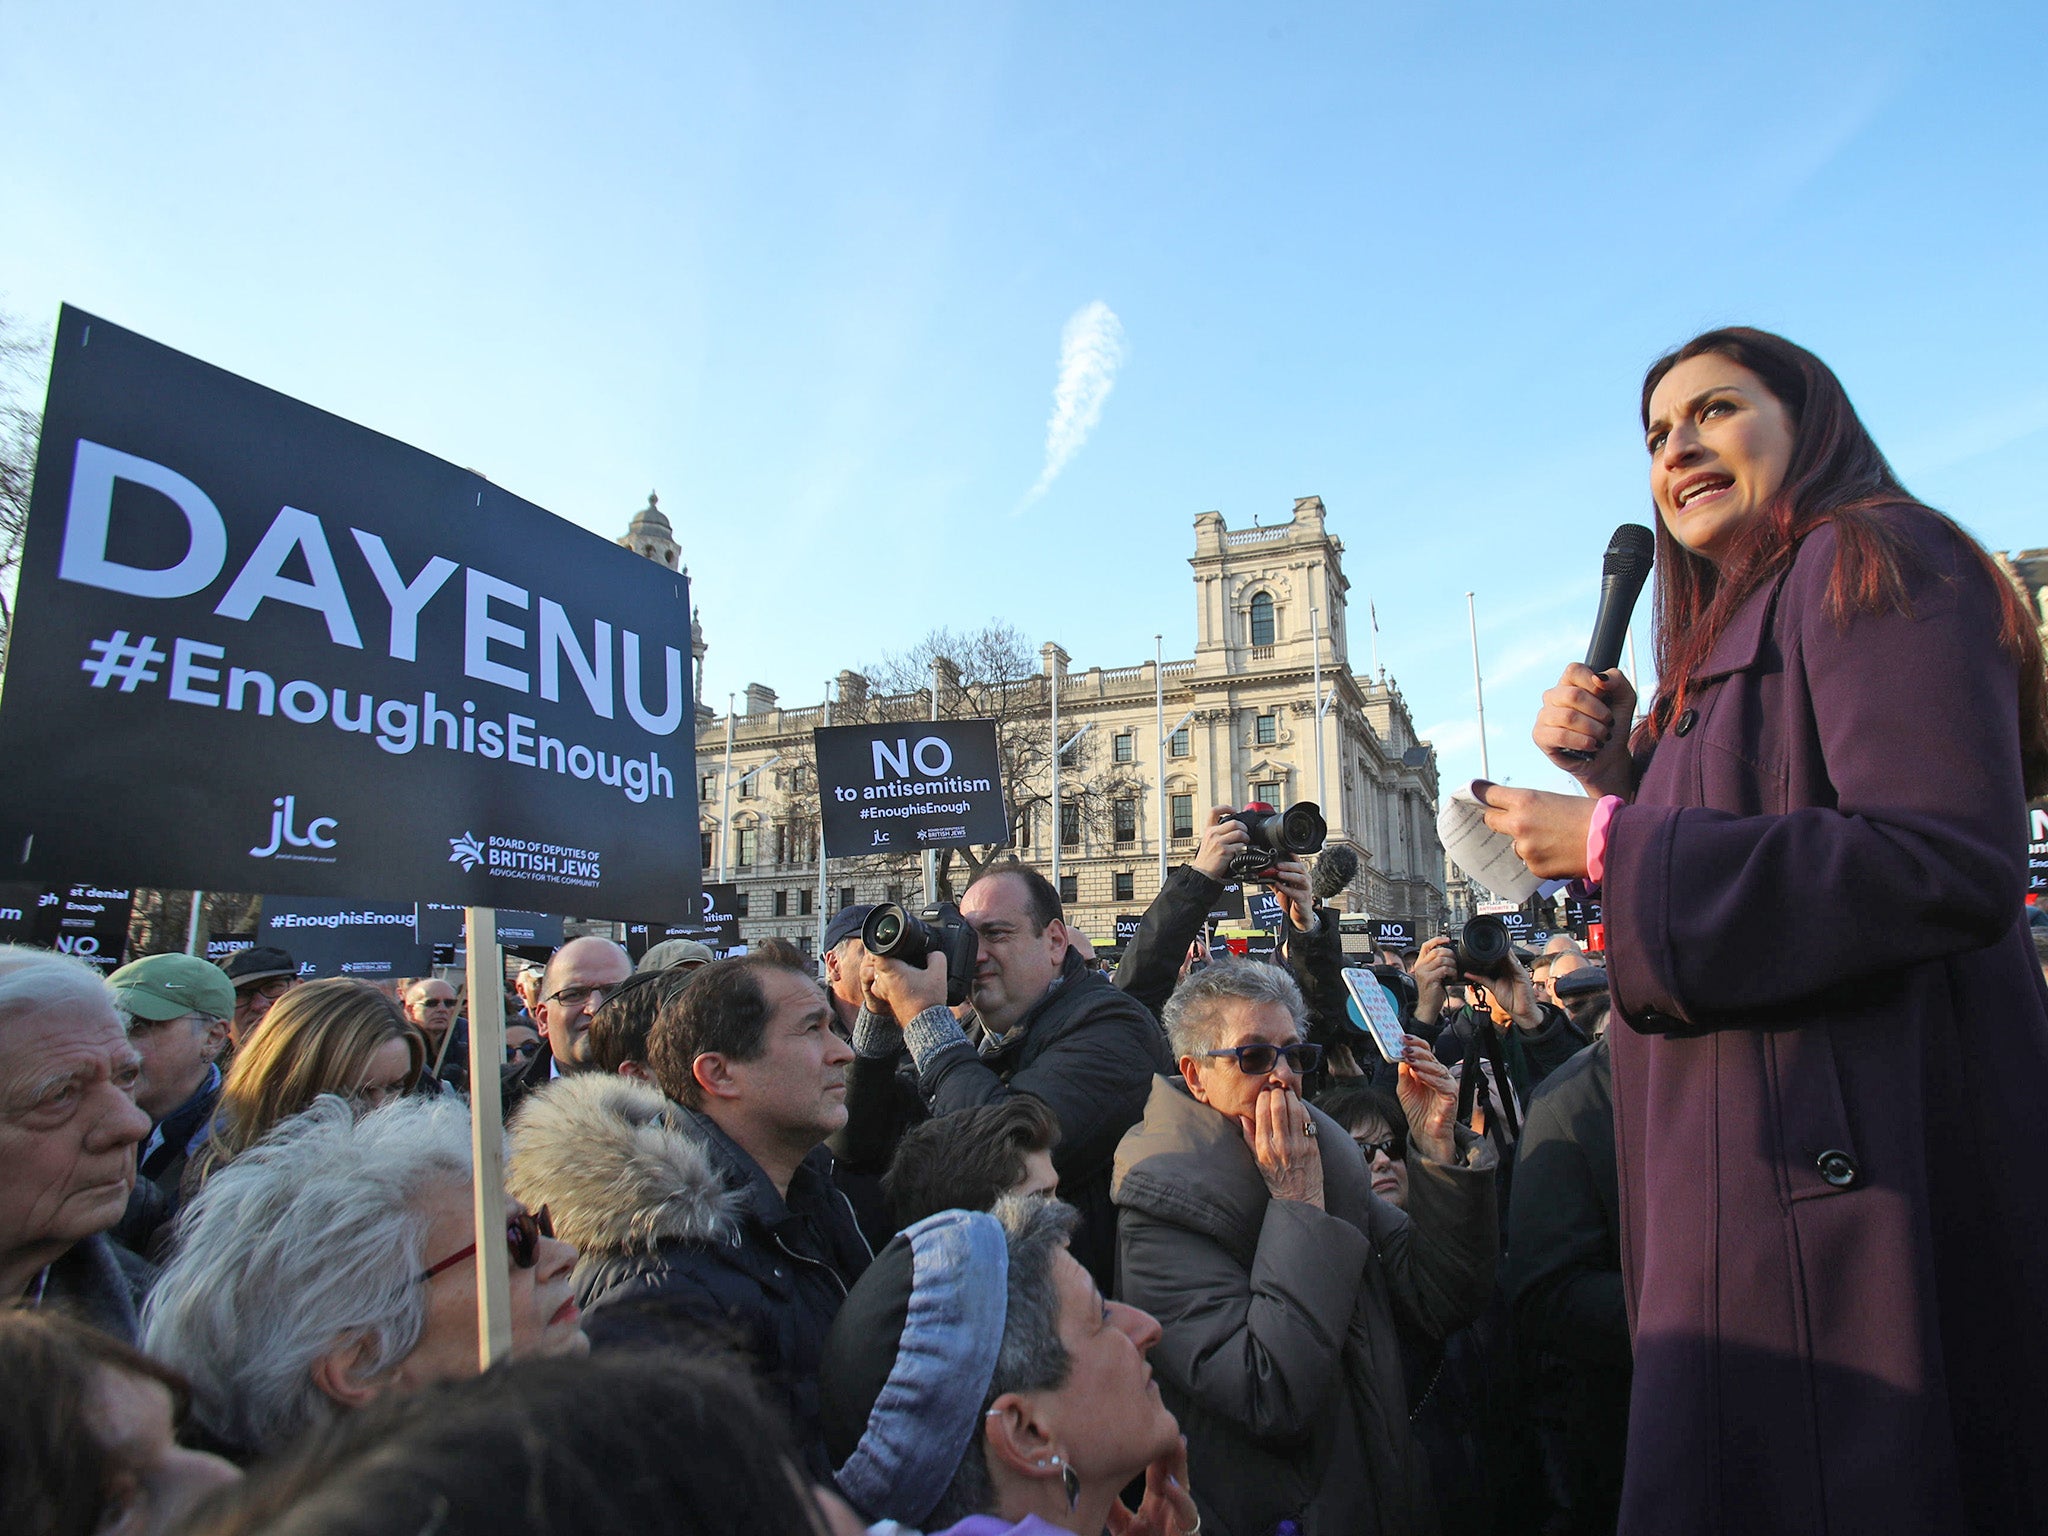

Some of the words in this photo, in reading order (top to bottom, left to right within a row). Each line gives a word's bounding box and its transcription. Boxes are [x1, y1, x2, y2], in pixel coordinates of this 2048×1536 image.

[58, 438, 683, 736] DAYENU
[81, 630, 674, 803] #EnoughisEnough
[871, 736, 953, 780] NO
[834, 785, 857, 802] to
[863, 776, 990, 800] antisemitism
[859, 800, 971, 819] #EnoughisEnough
[489, 836, 526, 850] BOARD
[527, 842, 541, 852] OF
[542, 843, 586, 860] DEPUTIES
[588, 851, 600, 861] OF
[489, 849, 556, 873] BRITISH
[559, 860, 601, 879] JEWS
[489, 868, 531, 880] ADVOCACY
[531, 873, 546, 882] FOR
[547, 875, 561, 883] THE
[561, 877, 600, 888] COMMUNITY
[85, 888, 130, 900] denial
[270, 911, 417, 929] #EnoughisEnoug
[1117, 922, 1140, 932] DAY
[1503, 914, 1523, 925] NO
[1381, 924, 1403, 936] NO
[57, 935, 100, 955] NO
[208, 941, 254, 952] DAYENU
